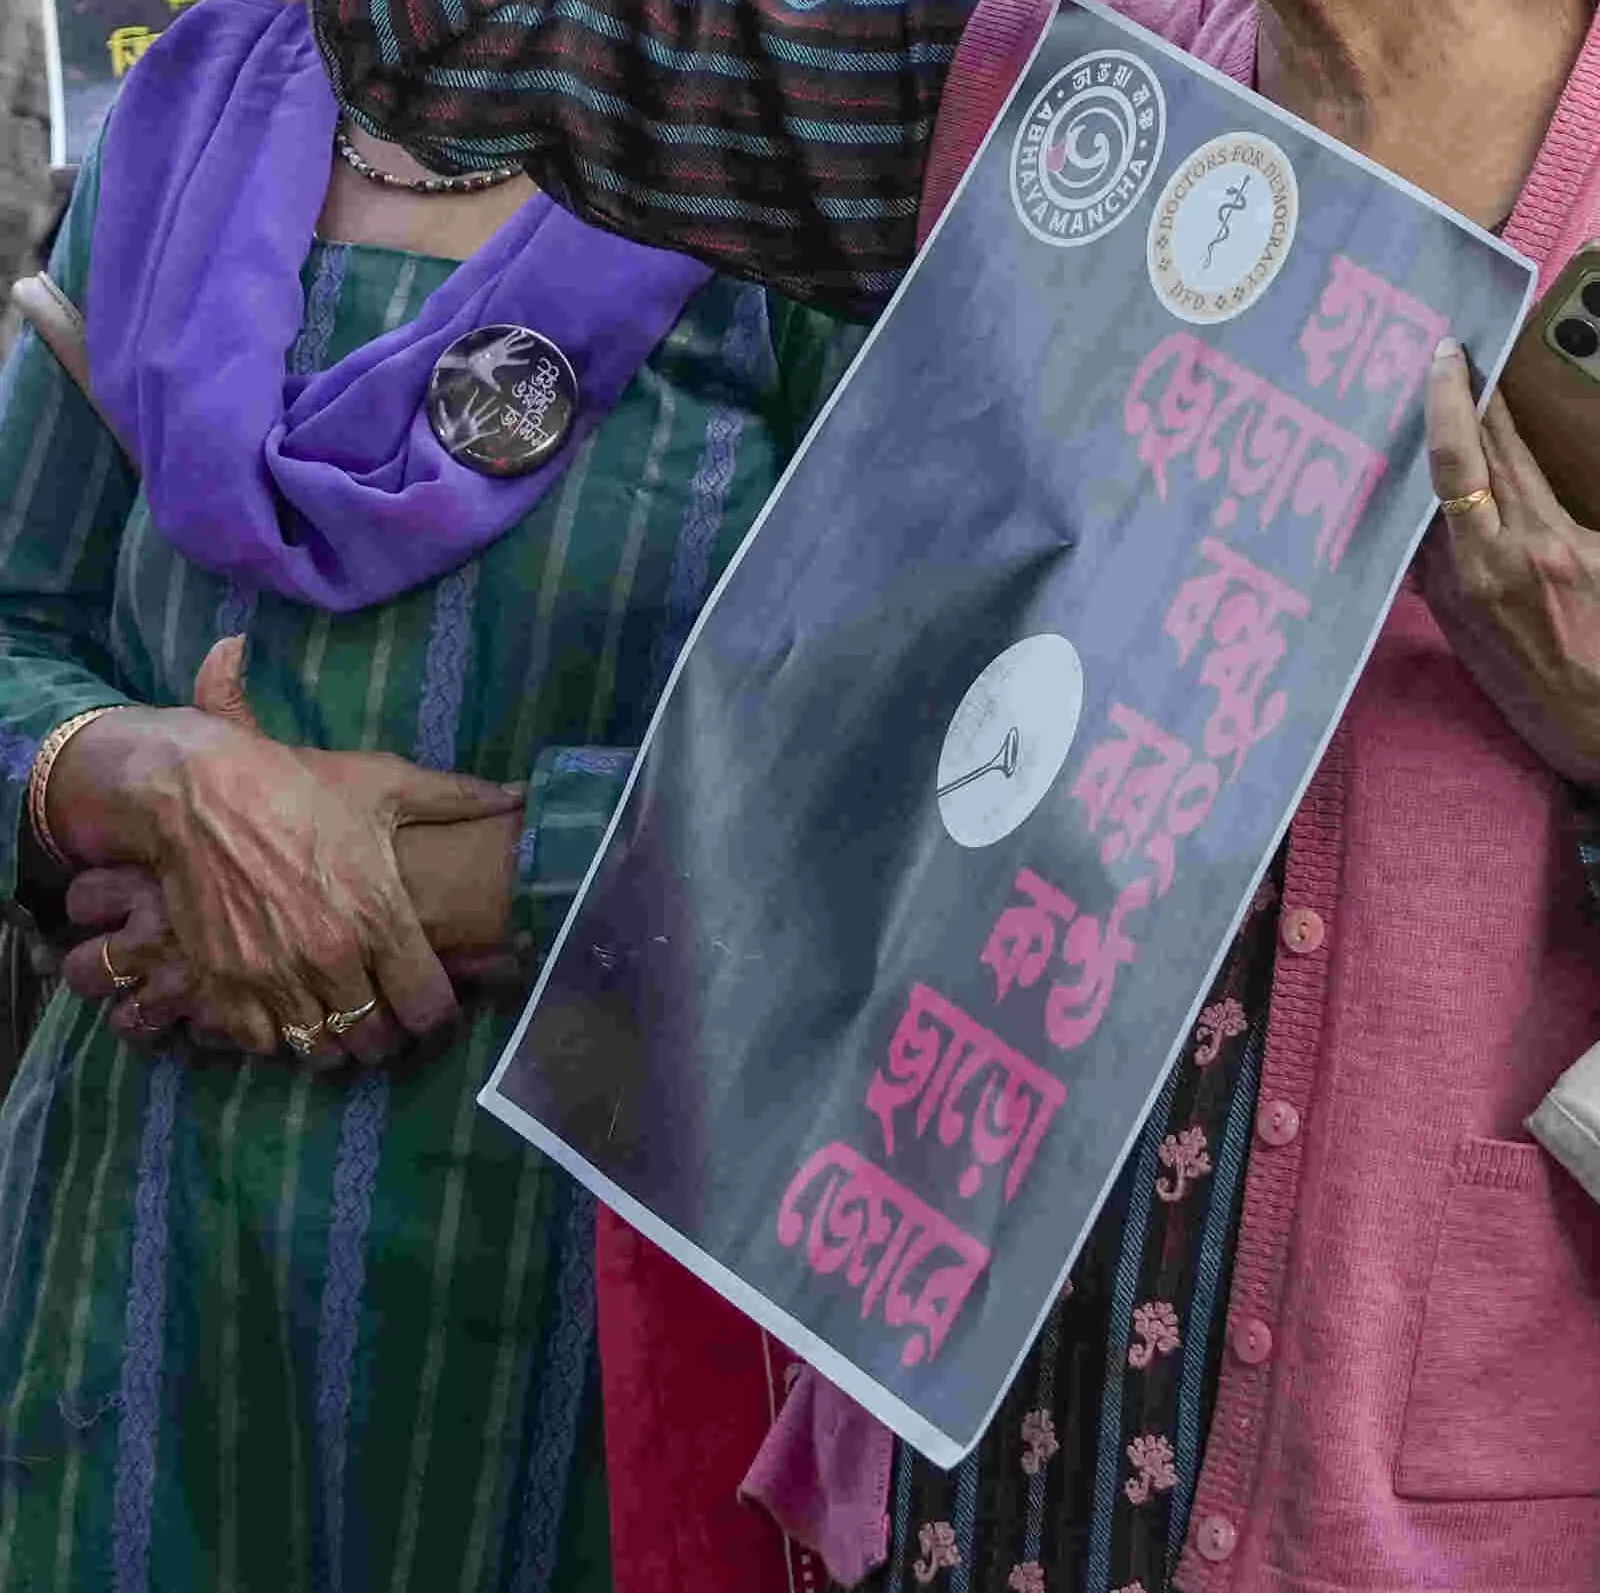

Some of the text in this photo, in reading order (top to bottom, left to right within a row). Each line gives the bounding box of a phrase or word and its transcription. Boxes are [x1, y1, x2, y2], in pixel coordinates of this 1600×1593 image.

[1020, 101, 1147, 235] ABHAYA MANCHA
[1160, 145, 1288, 287] DOCTORS FOR DEMOCRACY
